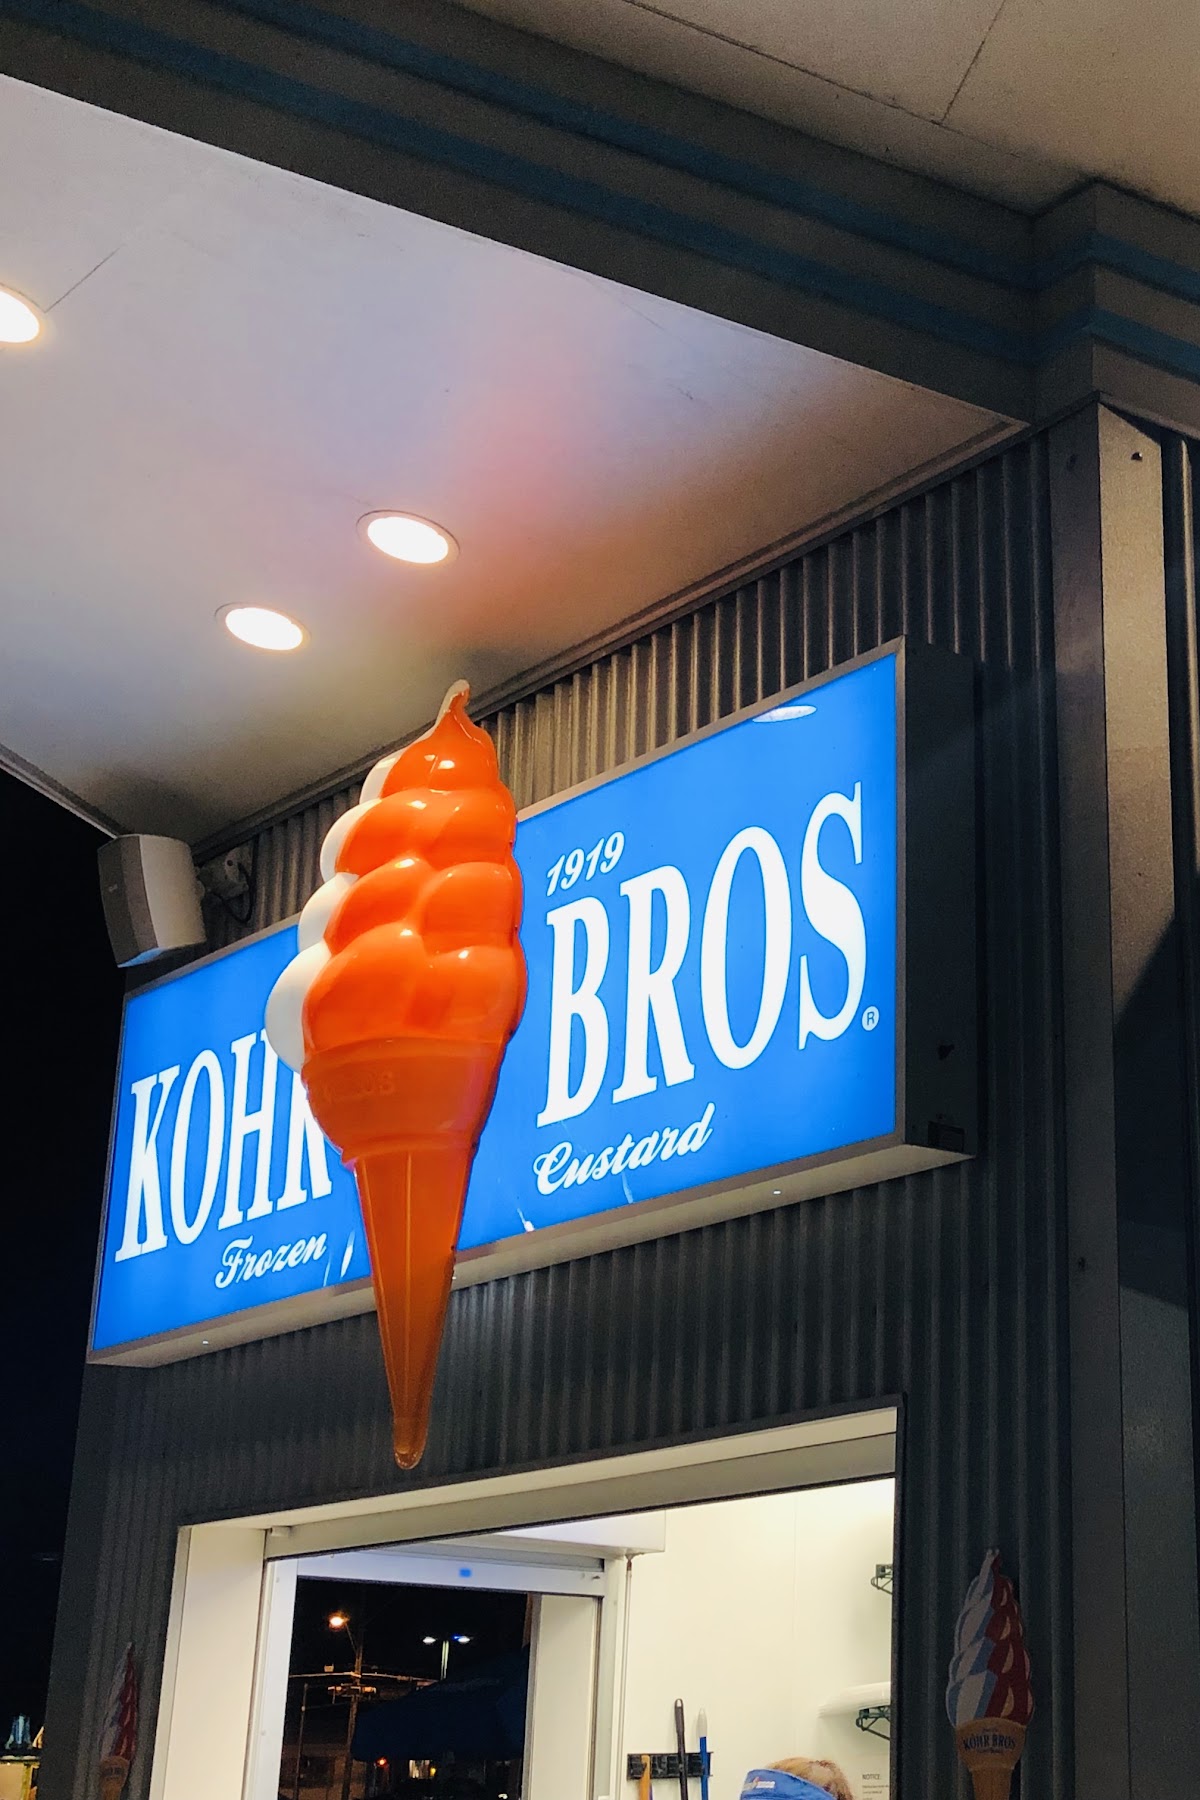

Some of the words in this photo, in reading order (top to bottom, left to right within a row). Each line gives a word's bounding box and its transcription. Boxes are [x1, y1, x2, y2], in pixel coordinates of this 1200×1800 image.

[535, 780, 867, 1128] BROS
[546, 830, 625, 897] 1919
[214, 1232, 327, 1289] Frozen
[533, 1102, 716, 1196] Custard
